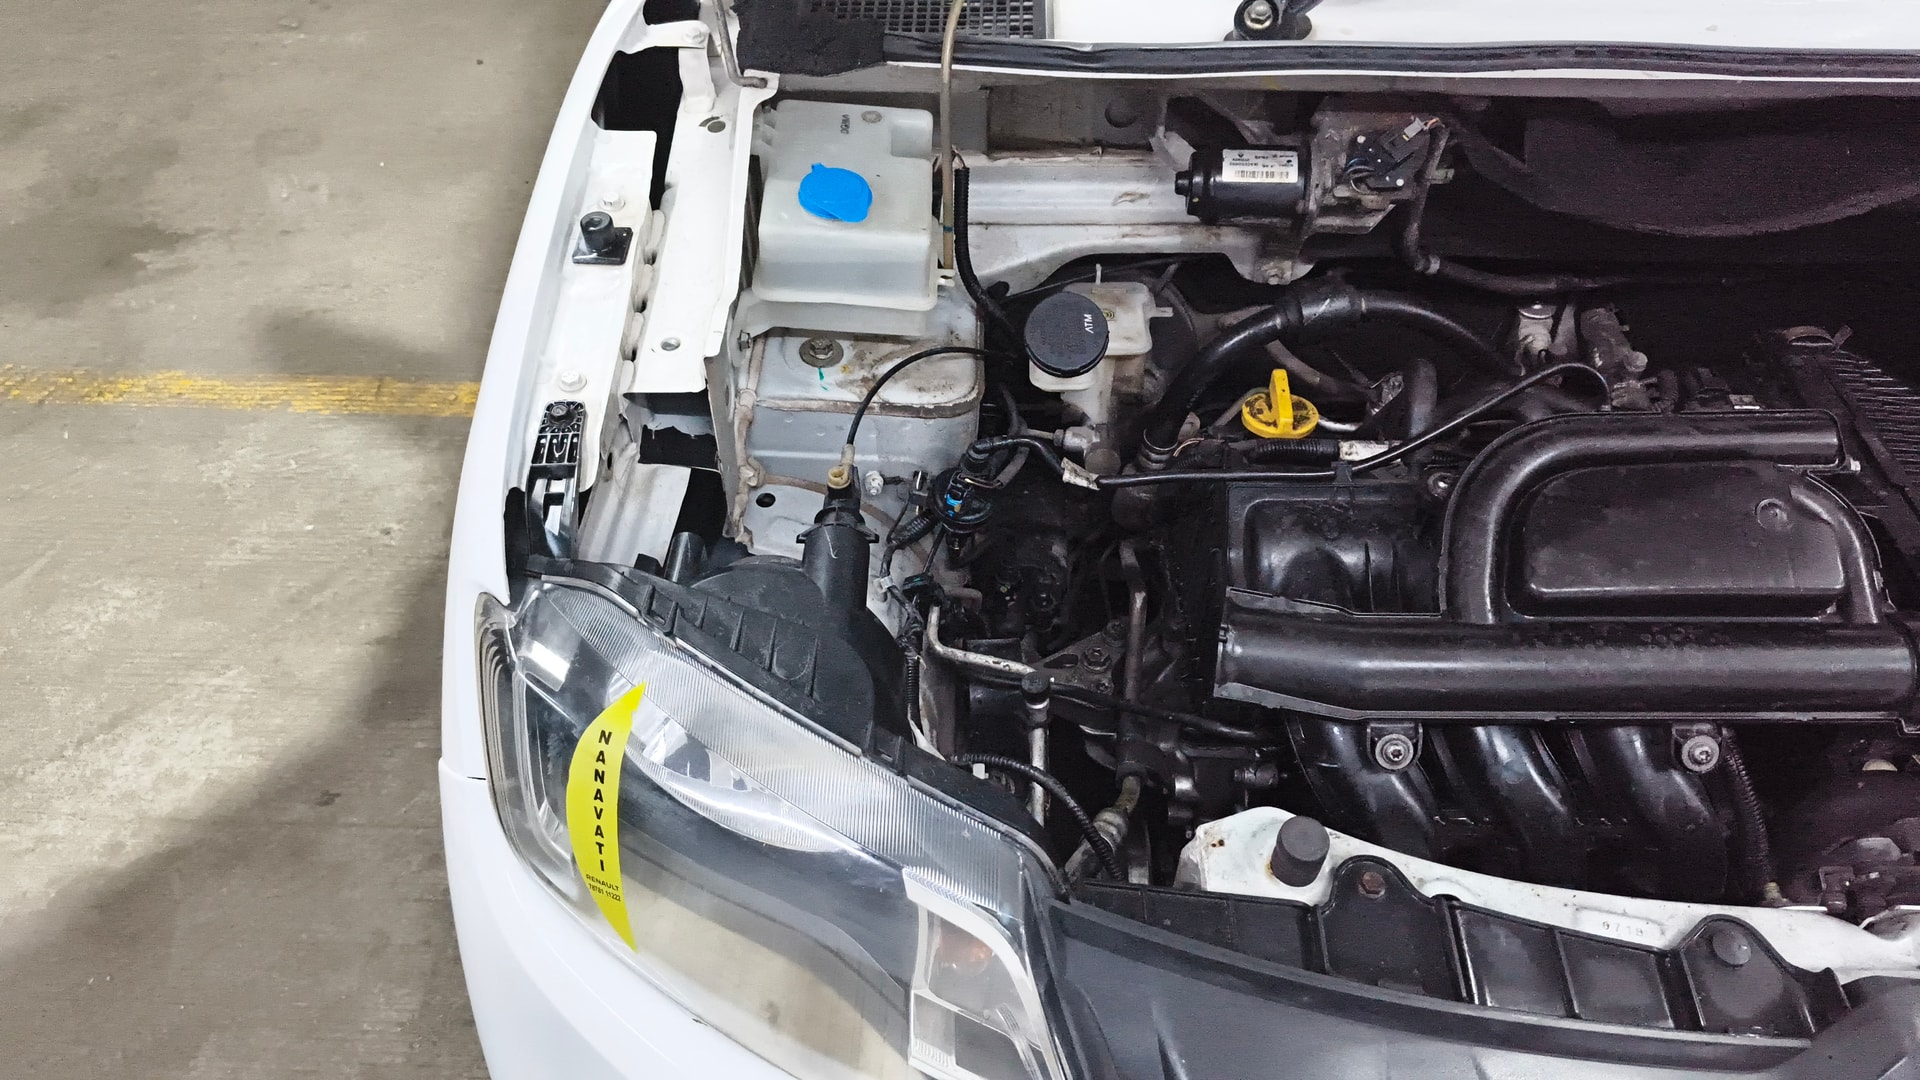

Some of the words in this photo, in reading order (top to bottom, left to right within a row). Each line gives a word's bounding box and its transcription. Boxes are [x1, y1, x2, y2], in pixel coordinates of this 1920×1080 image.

[1083, 313, 1094, 334] ATM
[594, 729, 612, 872] NANAVATI
[586, 874, 619, 891] RENAULT
